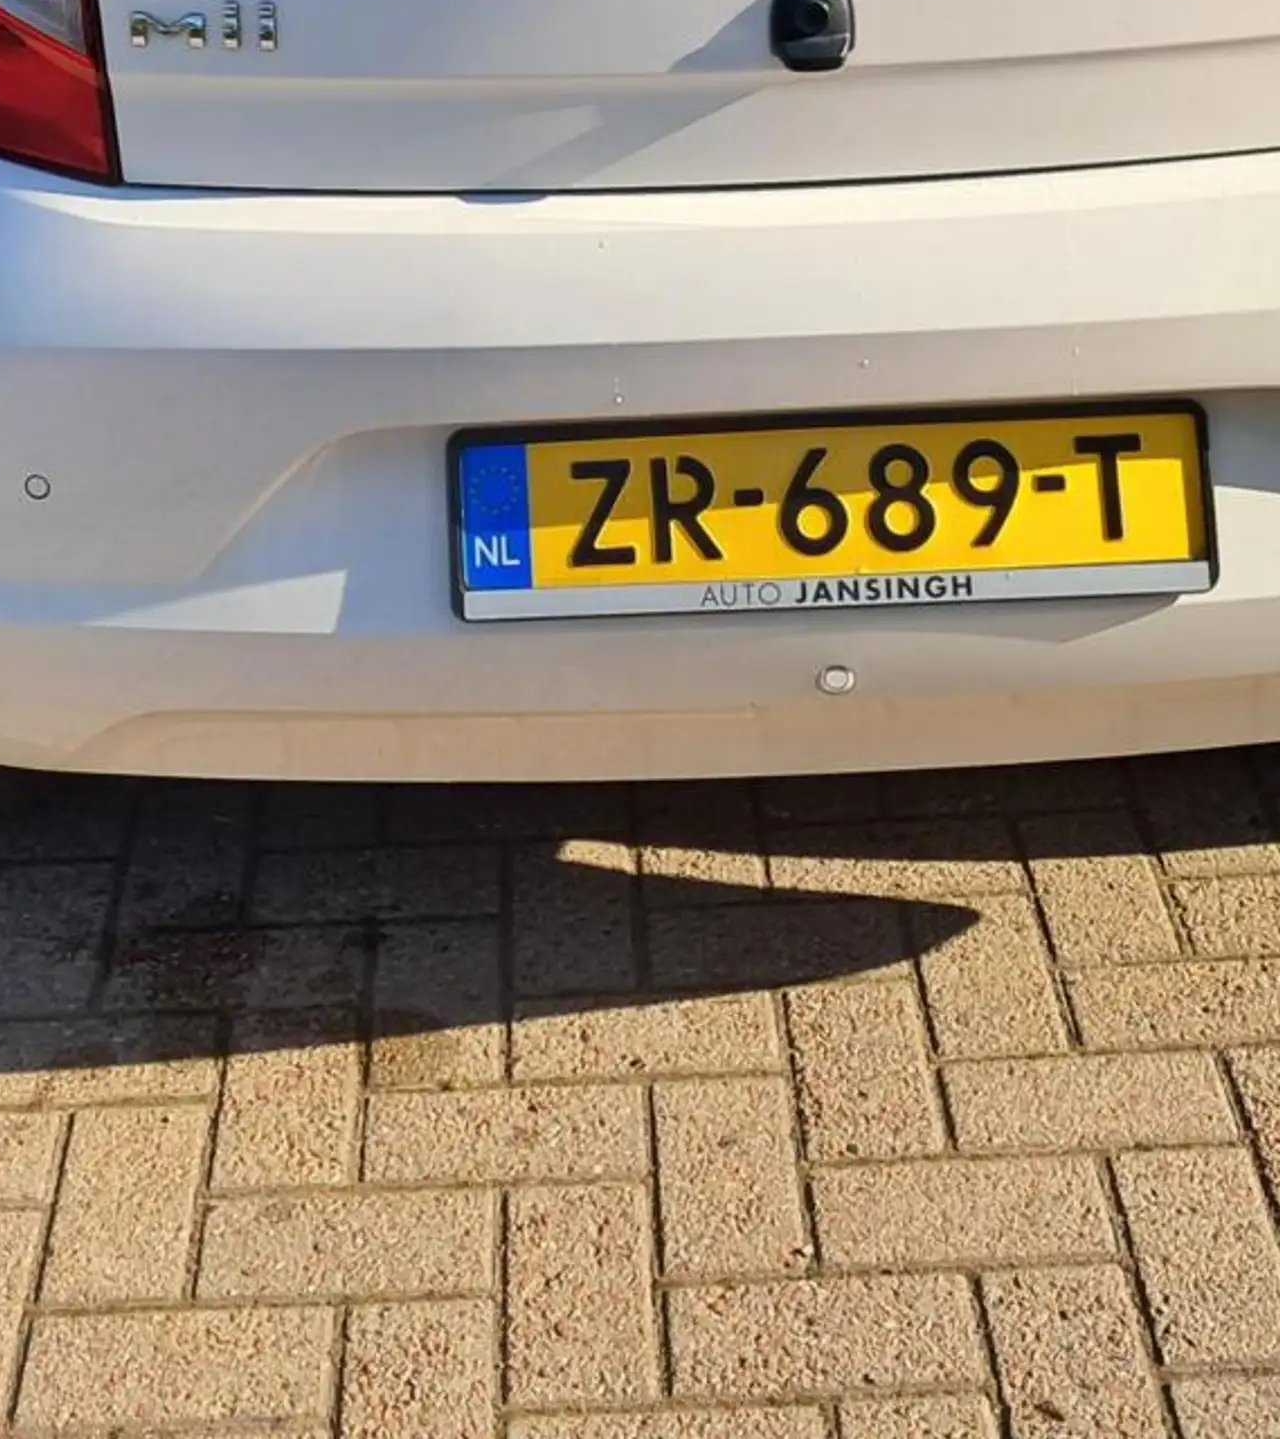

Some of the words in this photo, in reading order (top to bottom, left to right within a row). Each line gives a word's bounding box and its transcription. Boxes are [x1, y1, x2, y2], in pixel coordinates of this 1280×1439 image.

[566, 431, 1144, 569] ZR-689-T
[472, 533, 522, 569] NL
[700, 581, 782, 608] AUTO
[793, 573, 974, 606] JANSINGH
